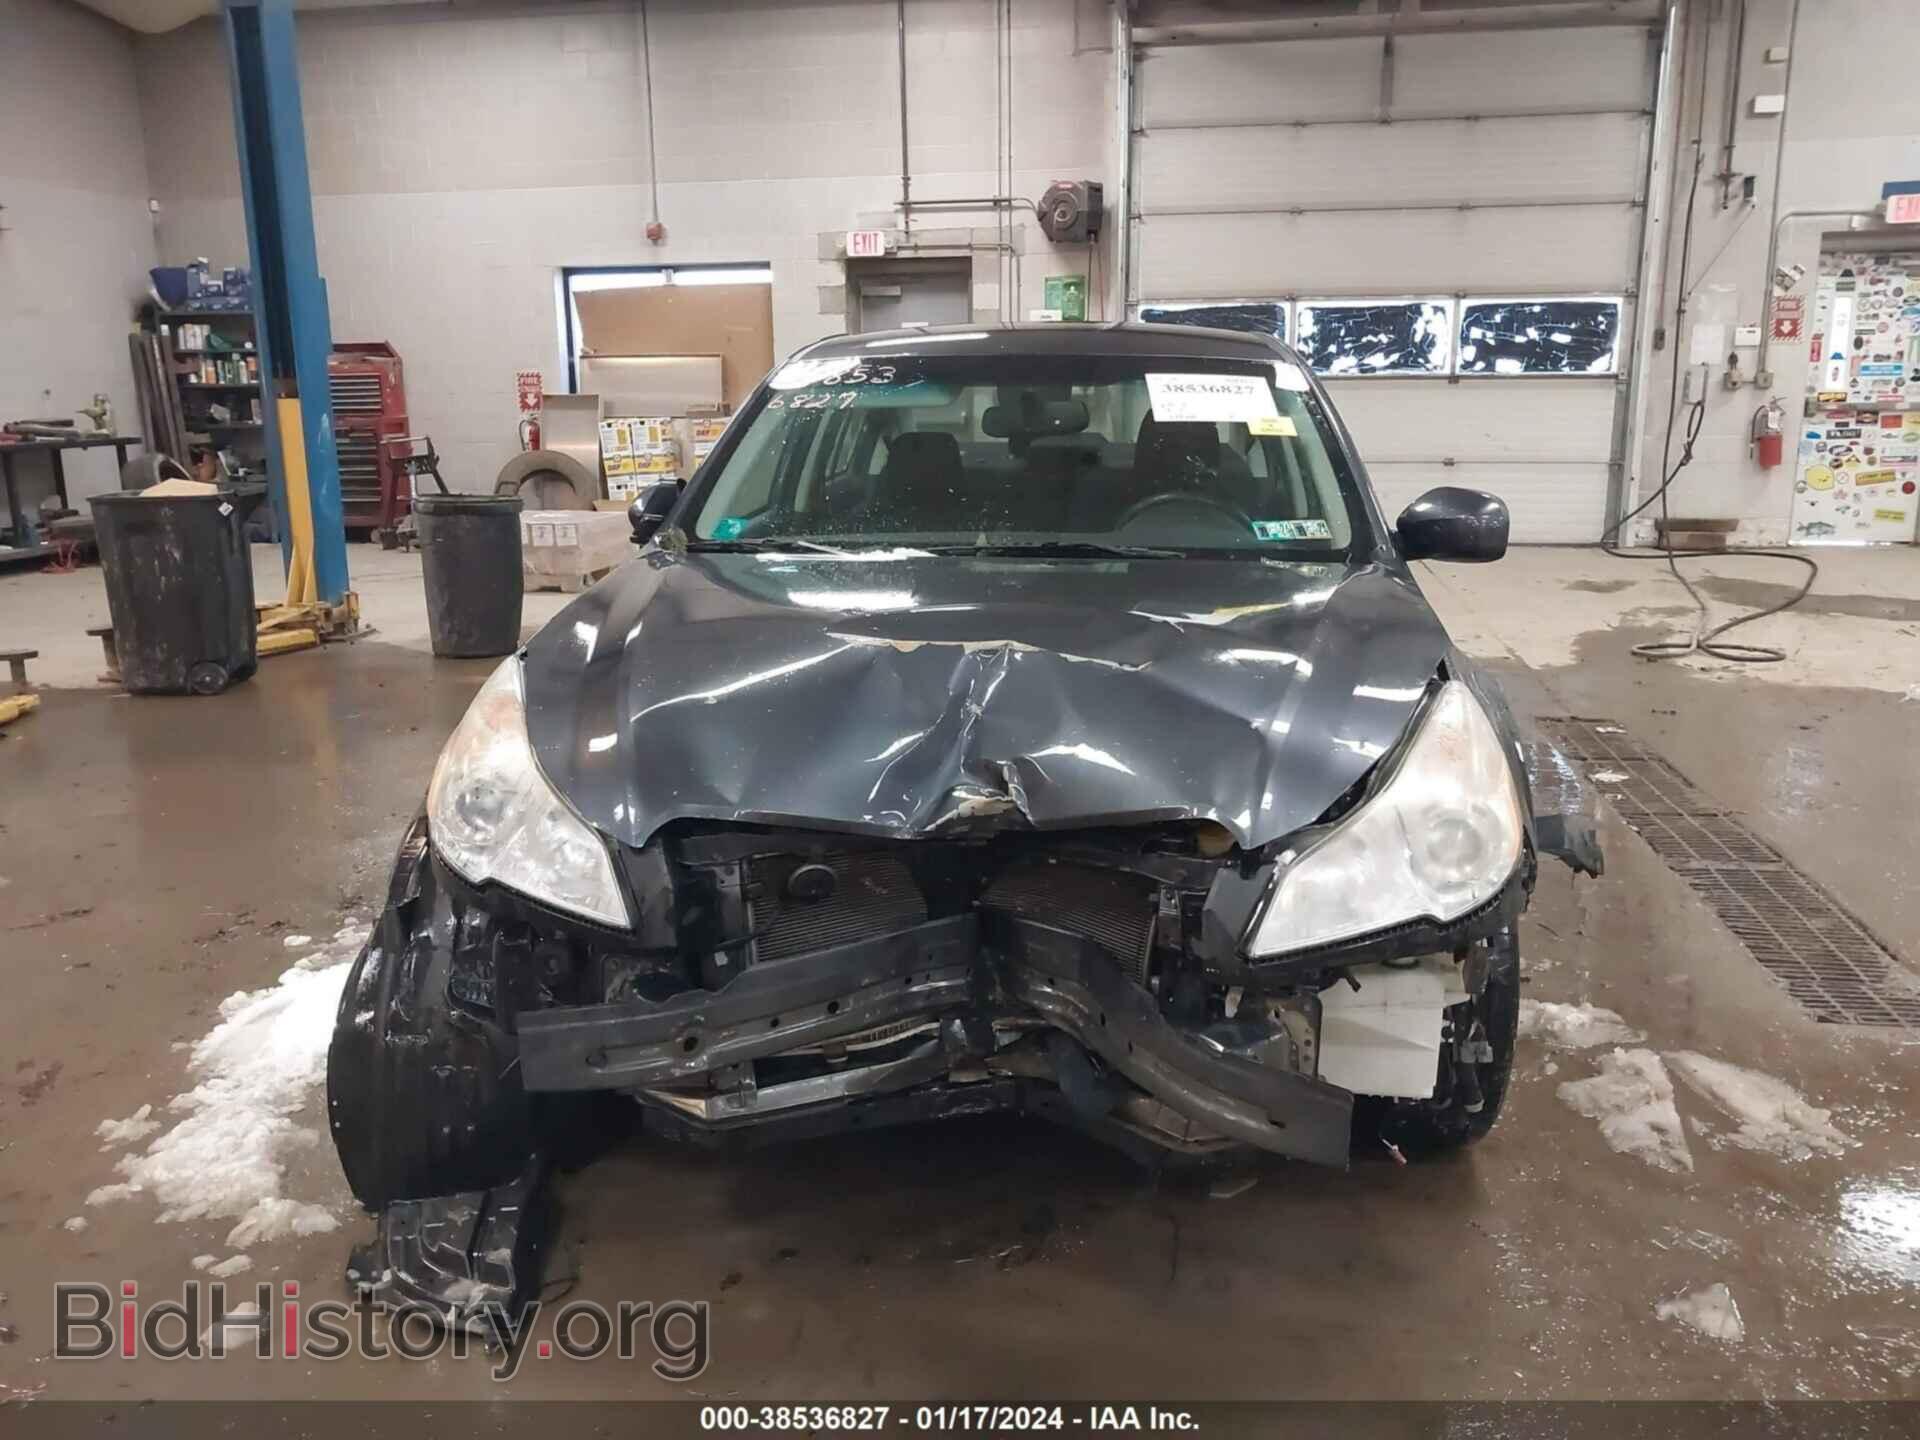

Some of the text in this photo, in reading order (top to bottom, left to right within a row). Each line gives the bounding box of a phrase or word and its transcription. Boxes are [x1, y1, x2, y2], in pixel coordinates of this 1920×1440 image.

[853, 232, 879, 254] EXIT
[1161, 384, 1255, 394] 38536827
[768, 391, 857, 409] 6827
